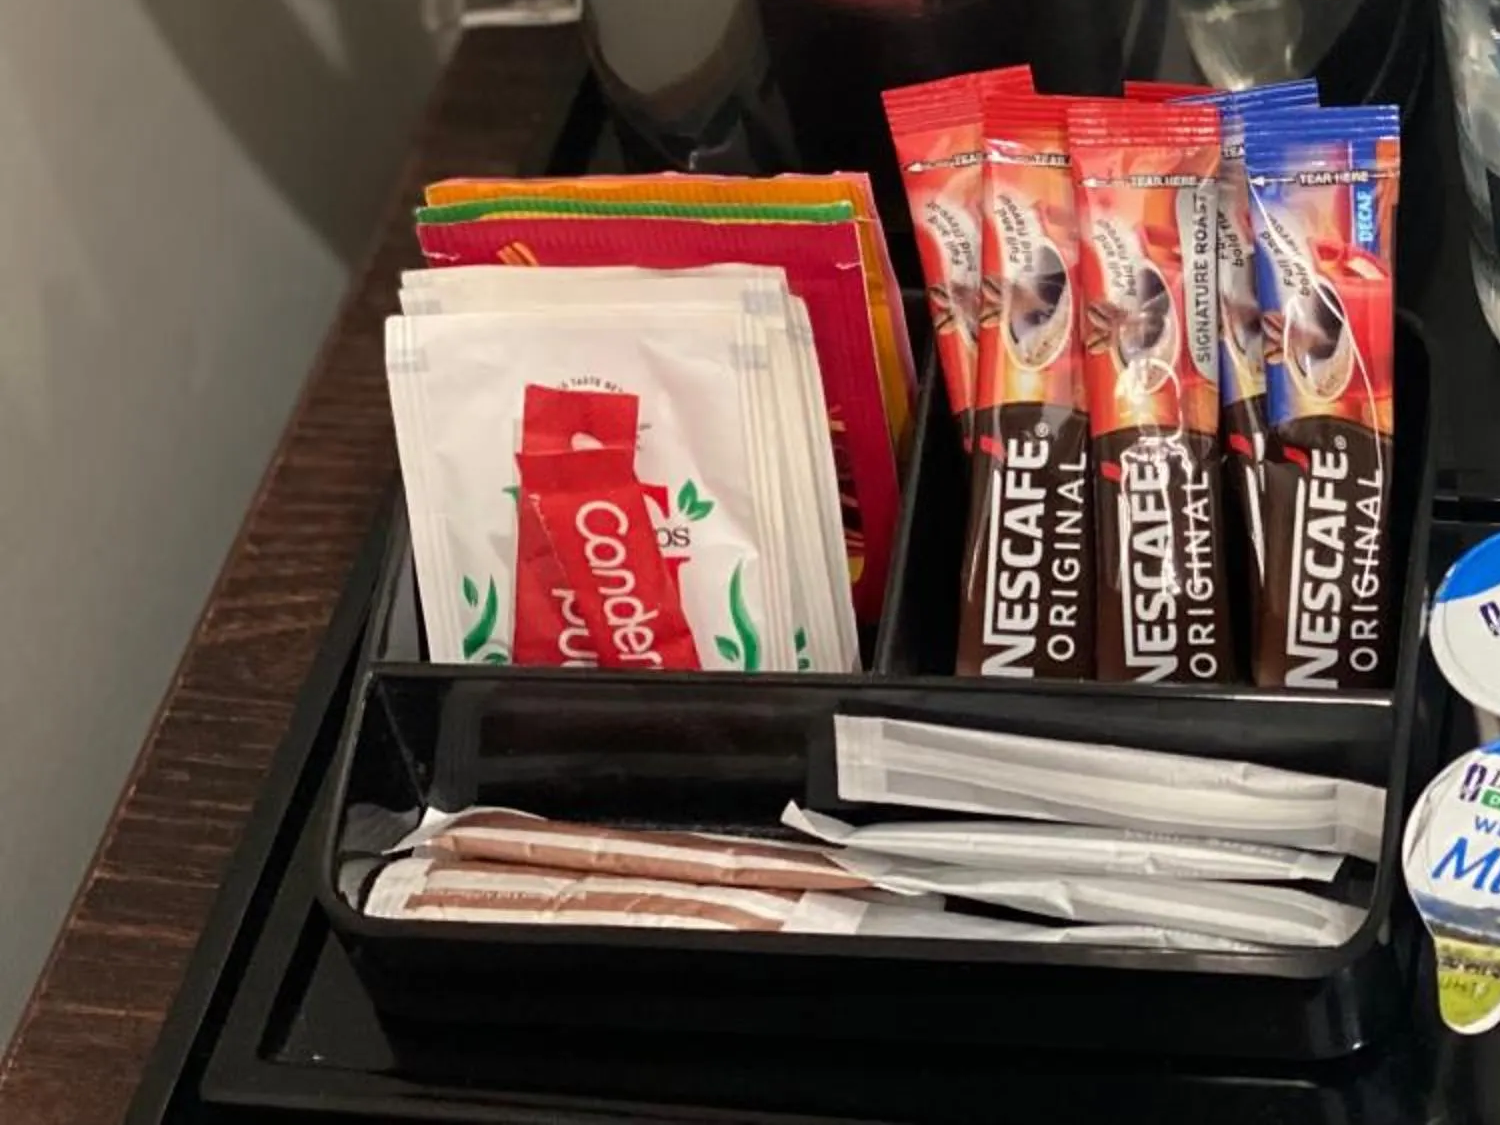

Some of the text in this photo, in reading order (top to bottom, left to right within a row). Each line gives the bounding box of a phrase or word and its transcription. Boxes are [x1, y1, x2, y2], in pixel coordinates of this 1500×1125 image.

[1300, 173, 1332, 187] TEAR
[1356, 190, 1374, 242] DECAF
[1192, 192, 1211, 363] SIGNATURE ROAST
[575, 500, 664, 668] Cander
[1047, 452, 1087, 661] ORIGINAL
[1182, 471, 1218, 679] ORIGINAL
[1349, 468, 1383, 673] ORIGINAL
